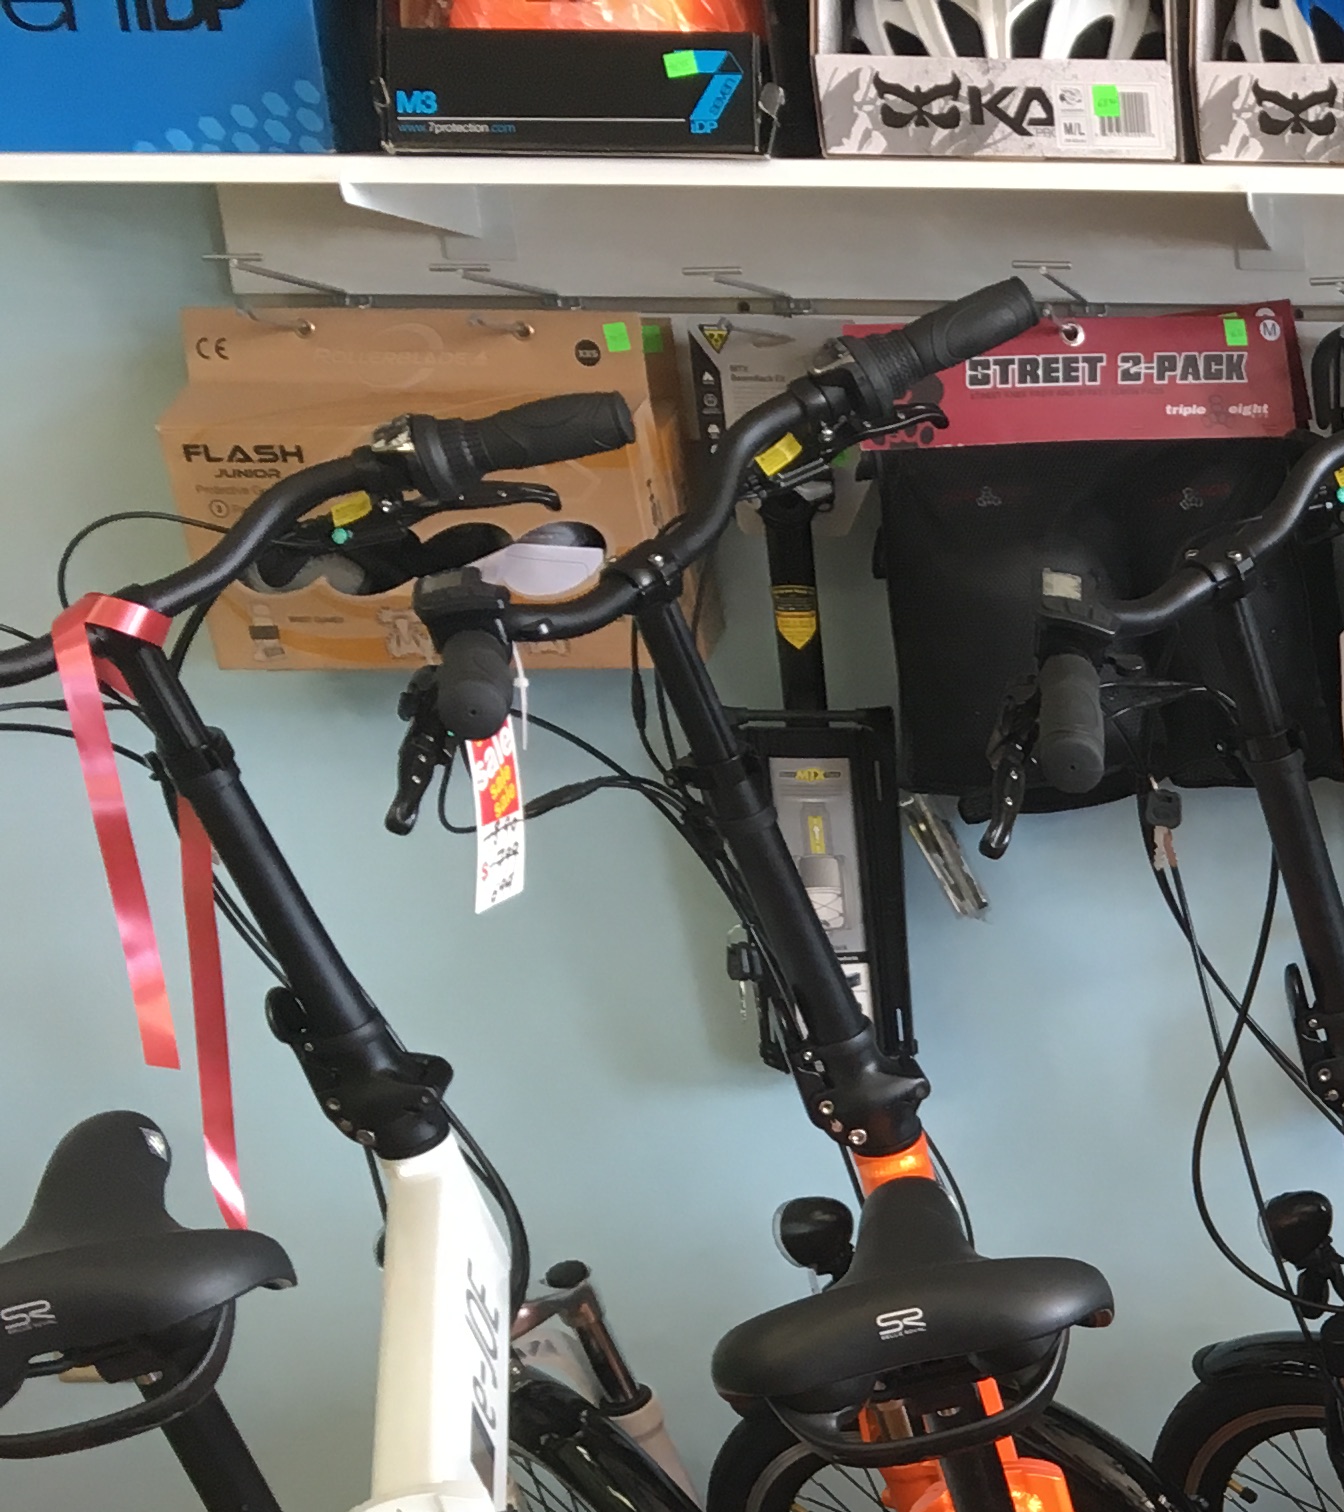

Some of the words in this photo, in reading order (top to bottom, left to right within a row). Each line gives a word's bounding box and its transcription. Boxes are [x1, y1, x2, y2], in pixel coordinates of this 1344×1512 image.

[395, 90, 438, 114] M3
[967, 86, 1055, 136] KA
[1063, 122, 1085, 136] M/L
[1262, 323, 1279, 337] M
[966, 353, 1106, 389] STREET
[1117, 351, 1249, 385] 2-PACK
[1165, 404, 1207, 417] triple
[1228, 403, 1269, 416] eight
[182, 443, 305, 464] FLASH
[214, 468, 281, 479] JUNIOR
[475, 725, 513, 792] sale
